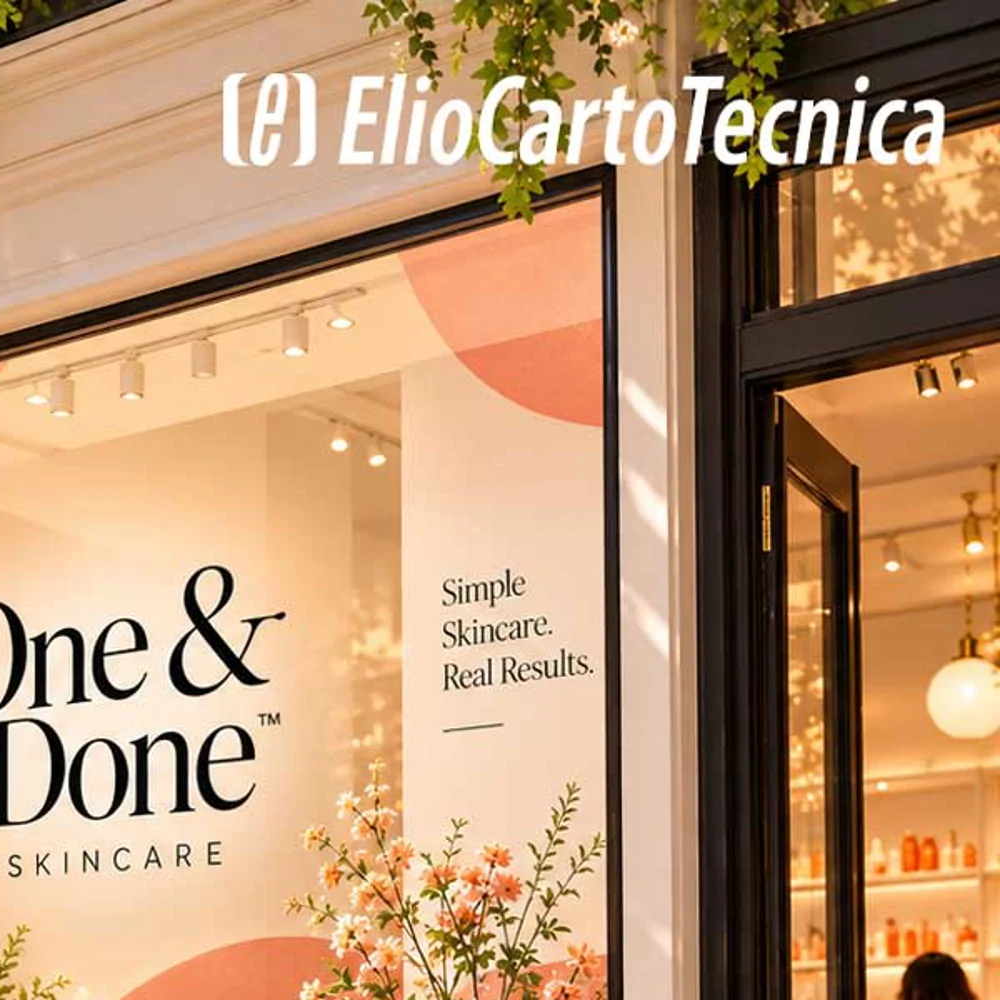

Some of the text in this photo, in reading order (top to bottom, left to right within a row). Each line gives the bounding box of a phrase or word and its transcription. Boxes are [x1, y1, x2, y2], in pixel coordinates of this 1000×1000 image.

[442, 568, 526, 607] Simple
[168, 564, 286, 697] &
[442, 615, 553, 649] Skincare.
[443, 648, 594, 691] Real Results.
[7, 841, 223, 878] SKINCARE
